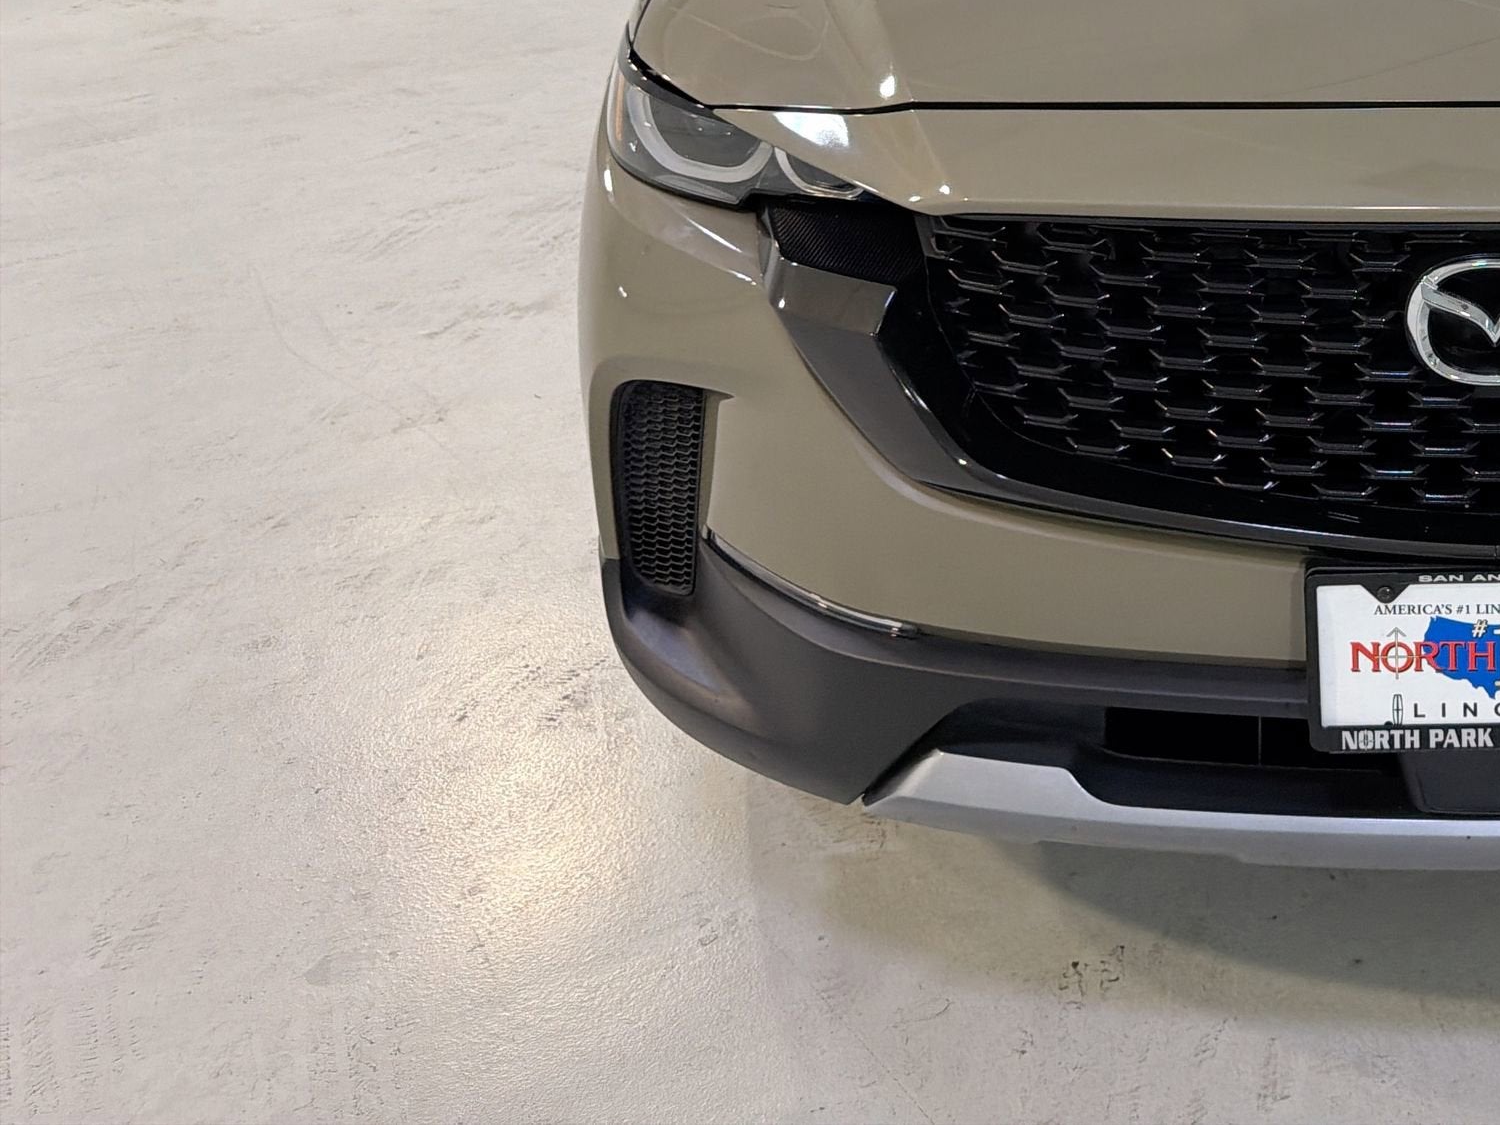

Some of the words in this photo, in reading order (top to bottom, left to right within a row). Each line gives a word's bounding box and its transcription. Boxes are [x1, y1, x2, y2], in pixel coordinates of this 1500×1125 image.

[1418, 574, 1464, 582] SAN
[1374, 604, 1453, 616] AMERICA'S
[1456, 604, 1471, 615] #1
[1350, 641, 1497, 673] NORTH
[1341, 728, 1421, 751] NORTH
[1428, 727, 1495, 749] PARK
